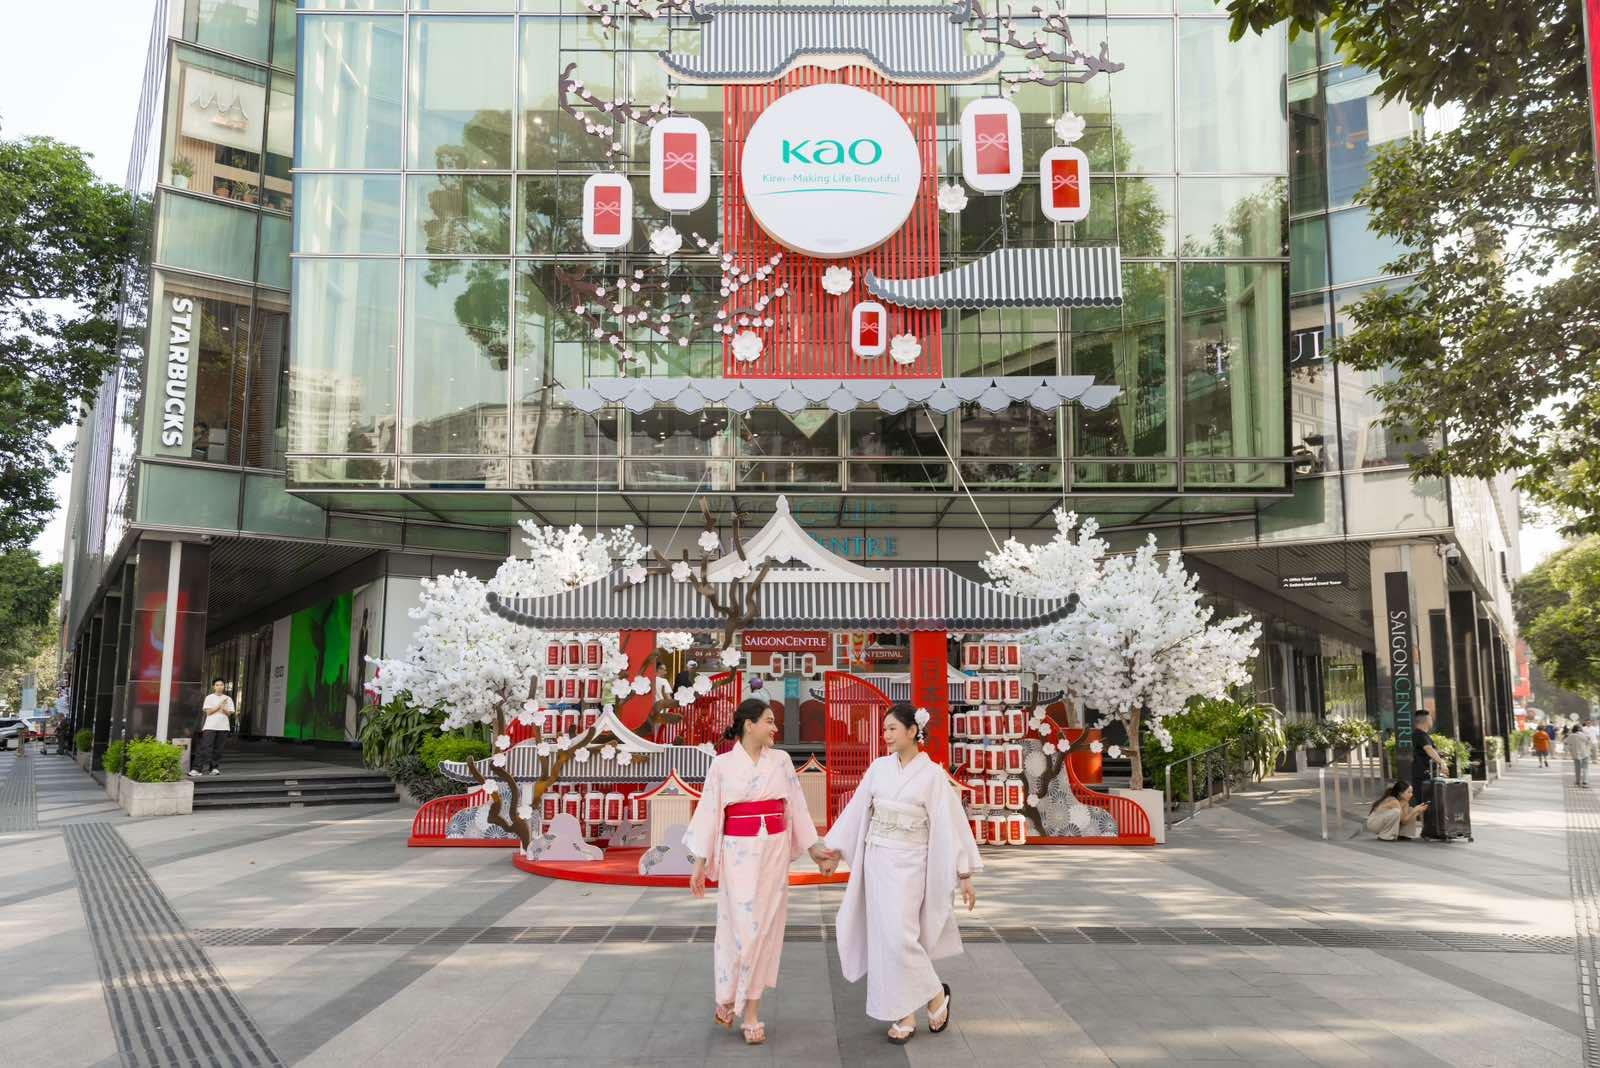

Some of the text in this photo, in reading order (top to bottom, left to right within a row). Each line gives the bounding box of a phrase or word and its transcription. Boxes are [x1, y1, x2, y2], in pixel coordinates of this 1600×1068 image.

[832, 173, 851, 183] Life
[854, 173, 899, 183] Beautiful
[162, 297, 193, 447] STARBUCKS
